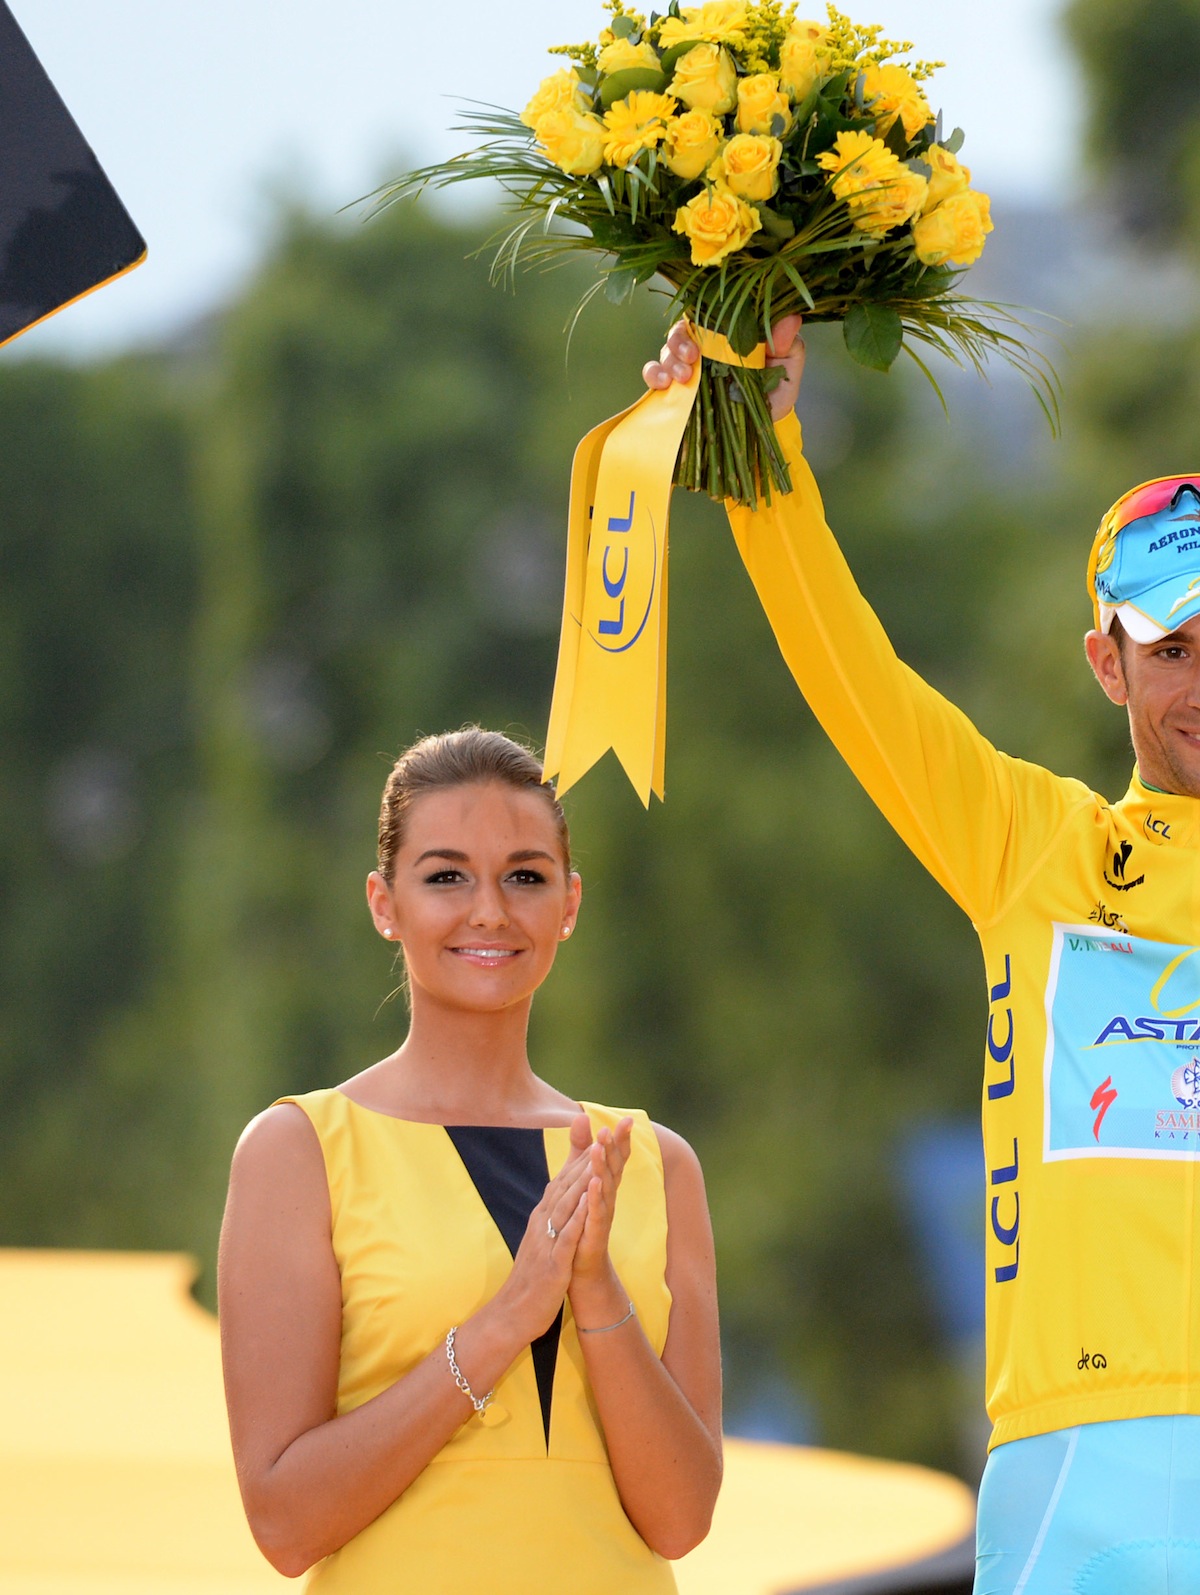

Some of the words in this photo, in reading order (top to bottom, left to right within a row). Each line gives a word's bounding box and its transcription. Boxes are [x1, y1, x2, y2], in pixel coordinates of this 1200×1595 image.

[598, 491, 635, 635] LCL
[1146, 813, 1171, 839] LCL
[987, 954, 1015, 1101] LCL
[991, 1137, 1020, 1284] LCL
